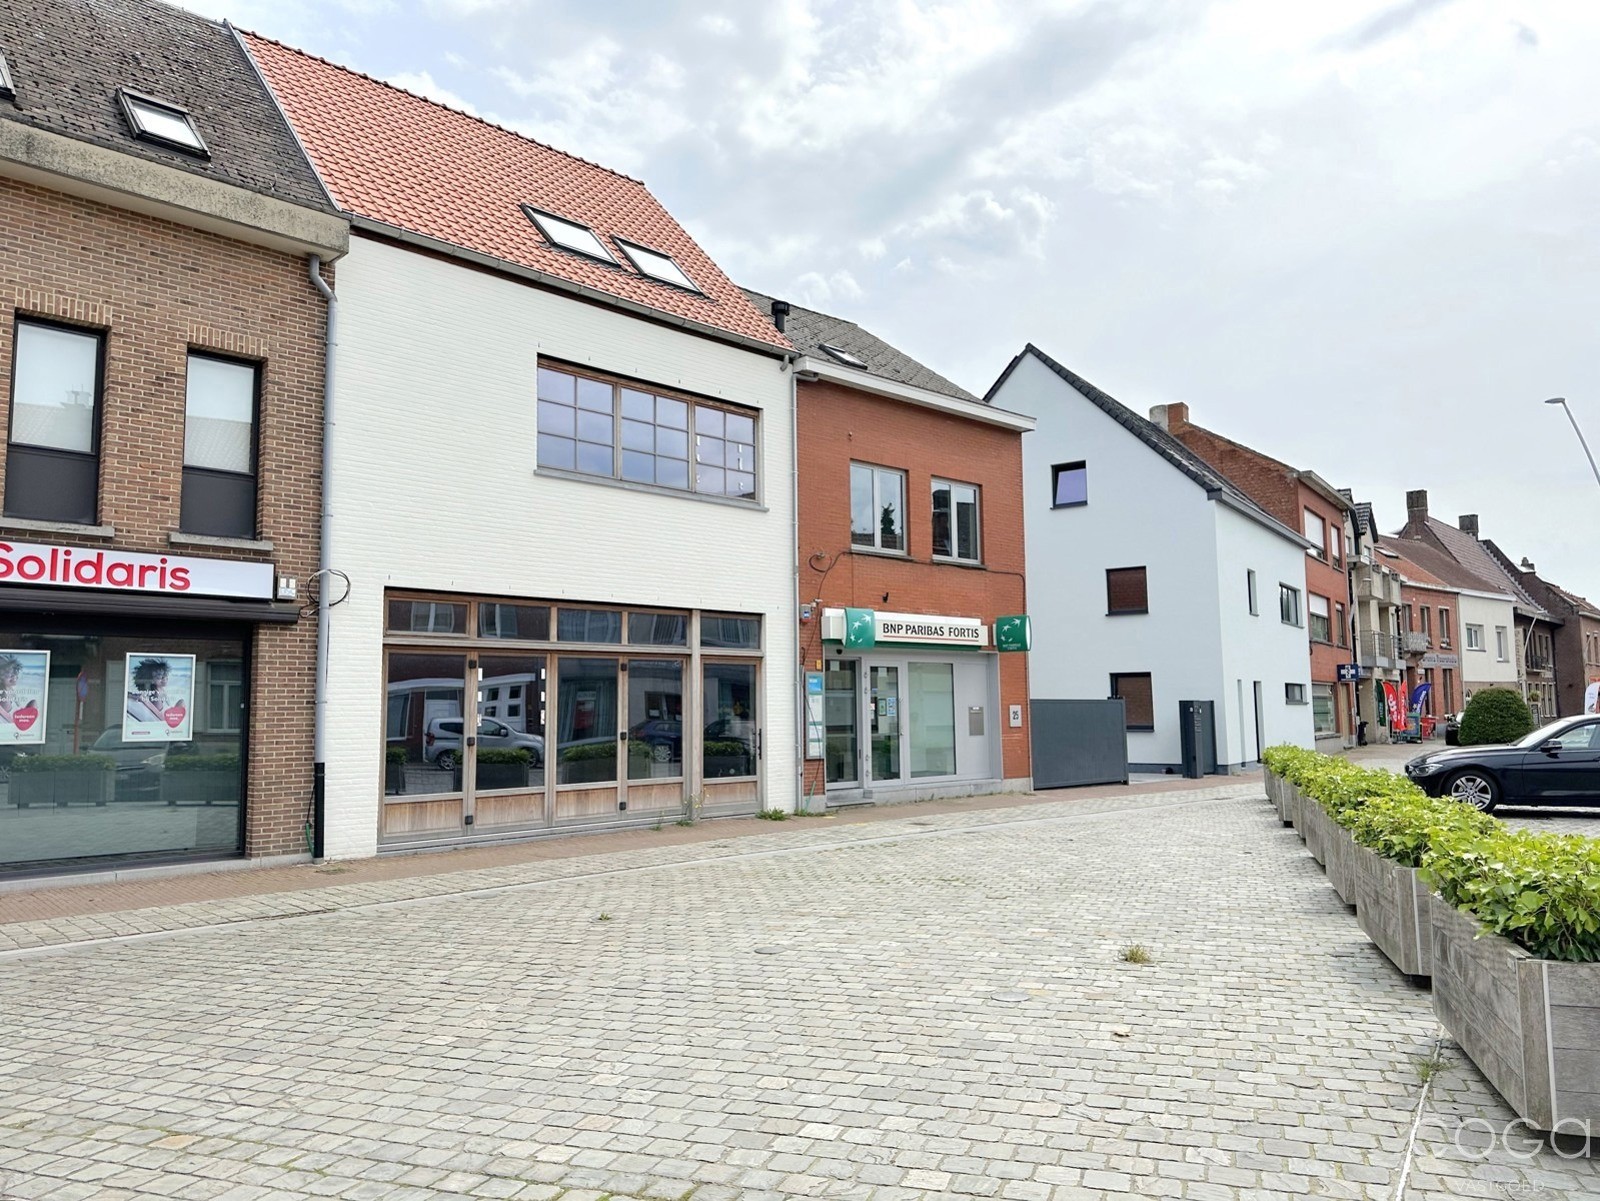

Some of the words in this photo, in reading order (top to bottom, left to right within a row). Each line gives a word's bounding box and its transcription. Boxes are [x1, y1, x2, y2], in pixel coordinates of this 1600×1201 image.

[0, 543, 190, 590] Solidaris
[882, 622, 903, 635] BNP
[905, 624, 945, 637] PARIBAS
[948, 626, 980, 639] FORTIS
[1012, 710, 1020, 721] 25
